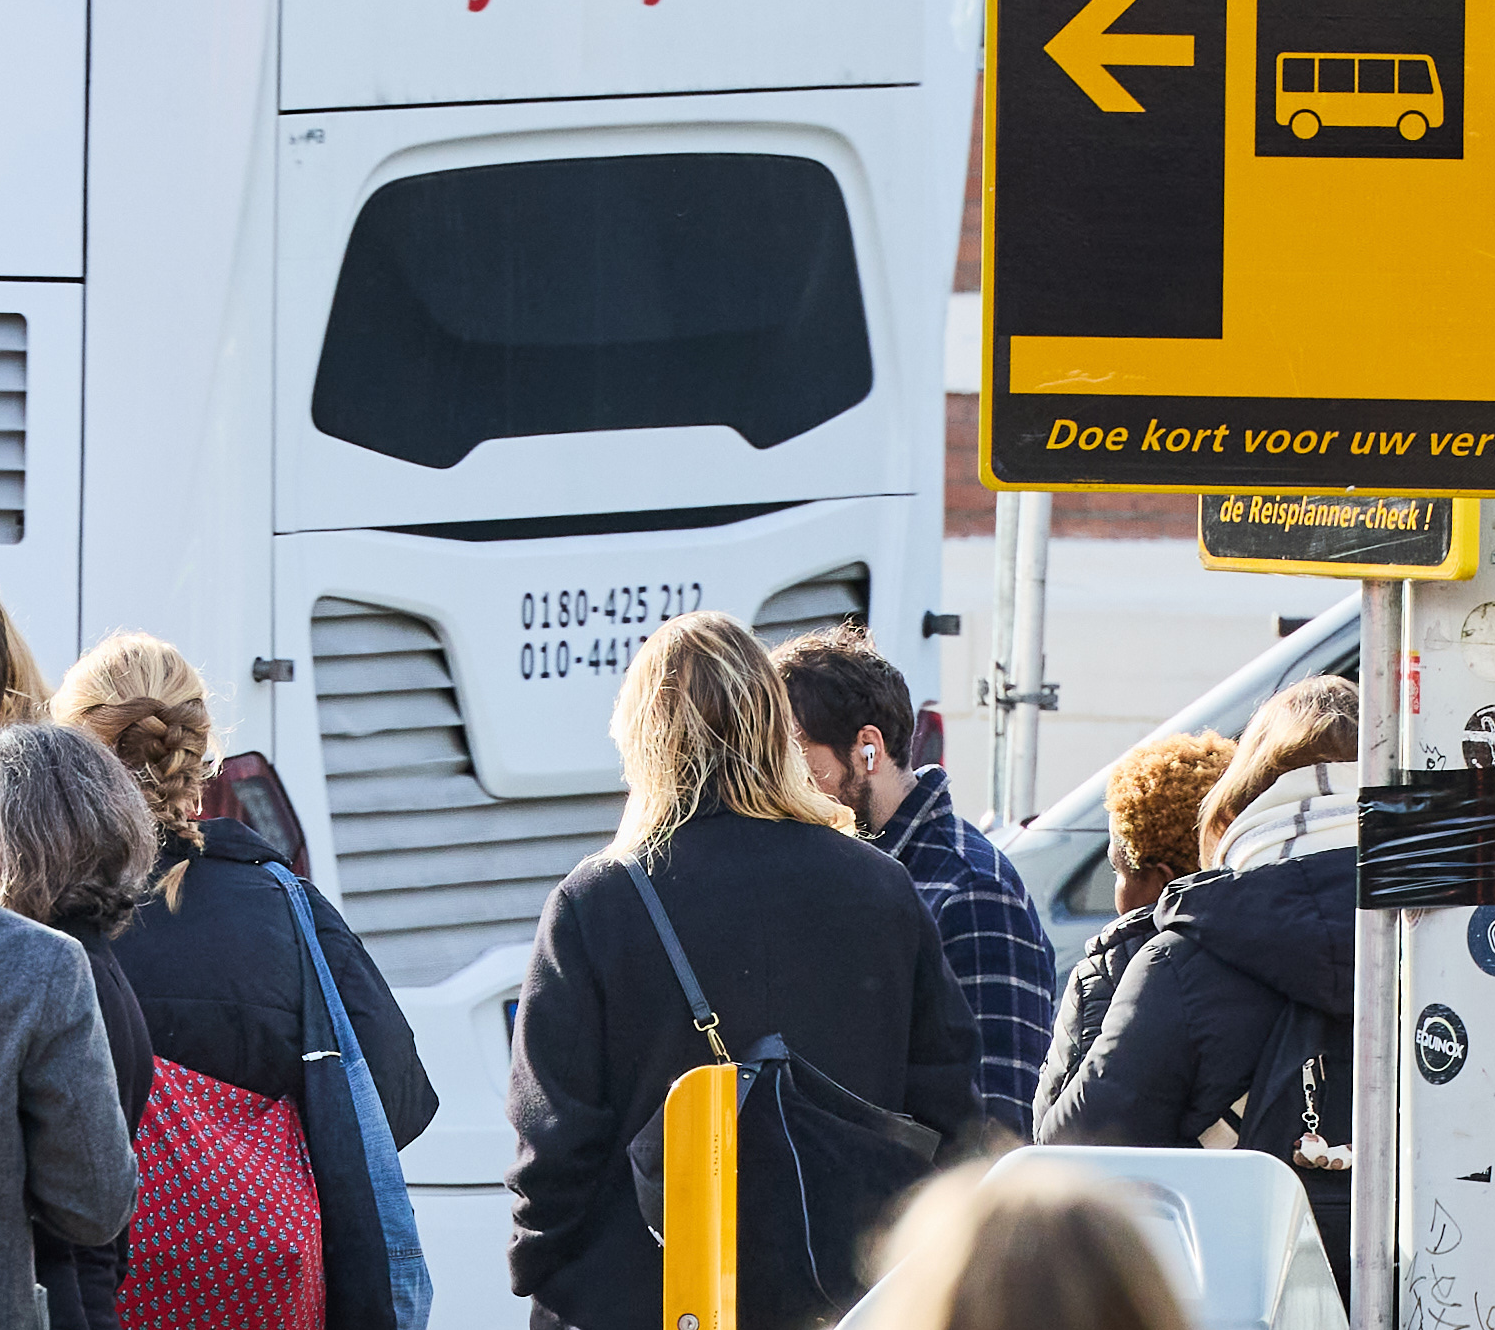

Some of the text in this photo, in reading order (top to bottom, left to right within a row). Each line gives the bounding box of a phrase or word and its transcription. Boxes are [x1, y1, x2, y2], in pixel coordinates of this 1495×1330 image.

[1045, 419, 1129, 451] Doe
[1140, 418, 1230, 453] kort
[1244, 429, 1340, 454] voor
[1350, 431, 1417, 455] uw
[1219, 495, 1244, 523] de
[1247, 496, 1420, 533] Reisplanner-check
[522, 582, 703, 631] 0180-425 212
[520, 635, 649, 680] 010-441
[1415, 1027, 1465, 1059] EQUINOX
